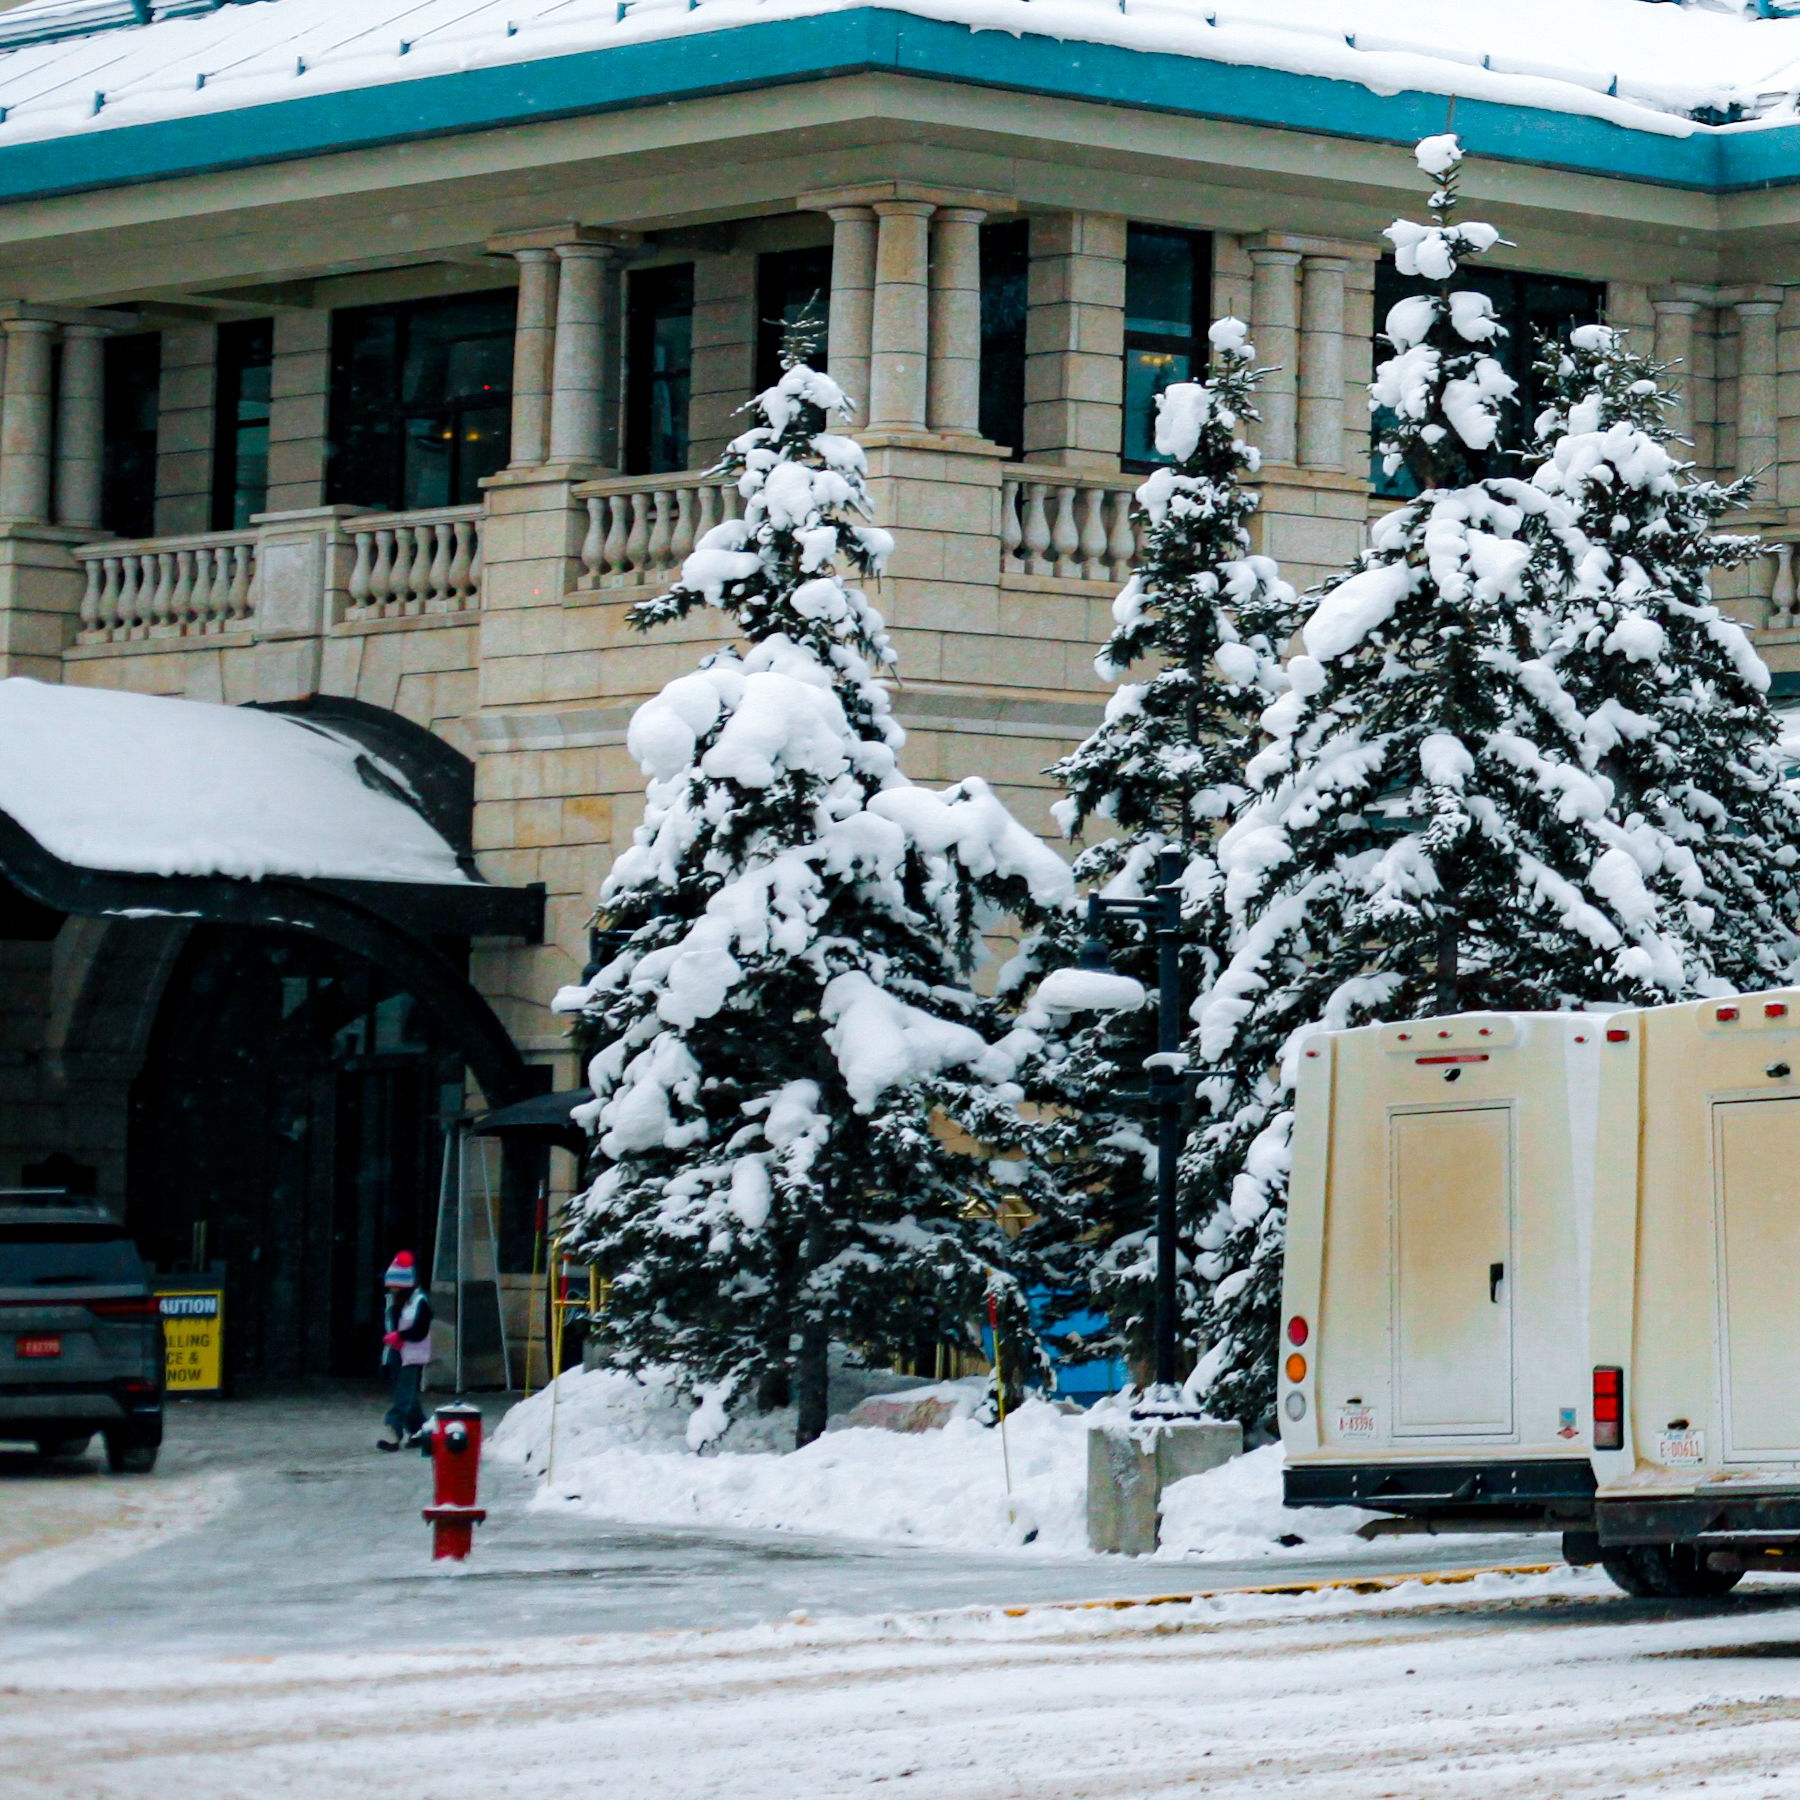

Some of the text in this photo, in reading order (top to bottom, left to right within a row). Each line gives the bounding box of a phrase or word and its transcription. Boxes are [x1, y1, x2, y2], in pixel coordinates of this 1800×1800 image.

[159, 1297, 217, 1314] AUTION
[167, 1334, 210, 1347] LLING
[166, 1351, 199, 1365] CE &
[167, 1369, 202, 1382] NOW
